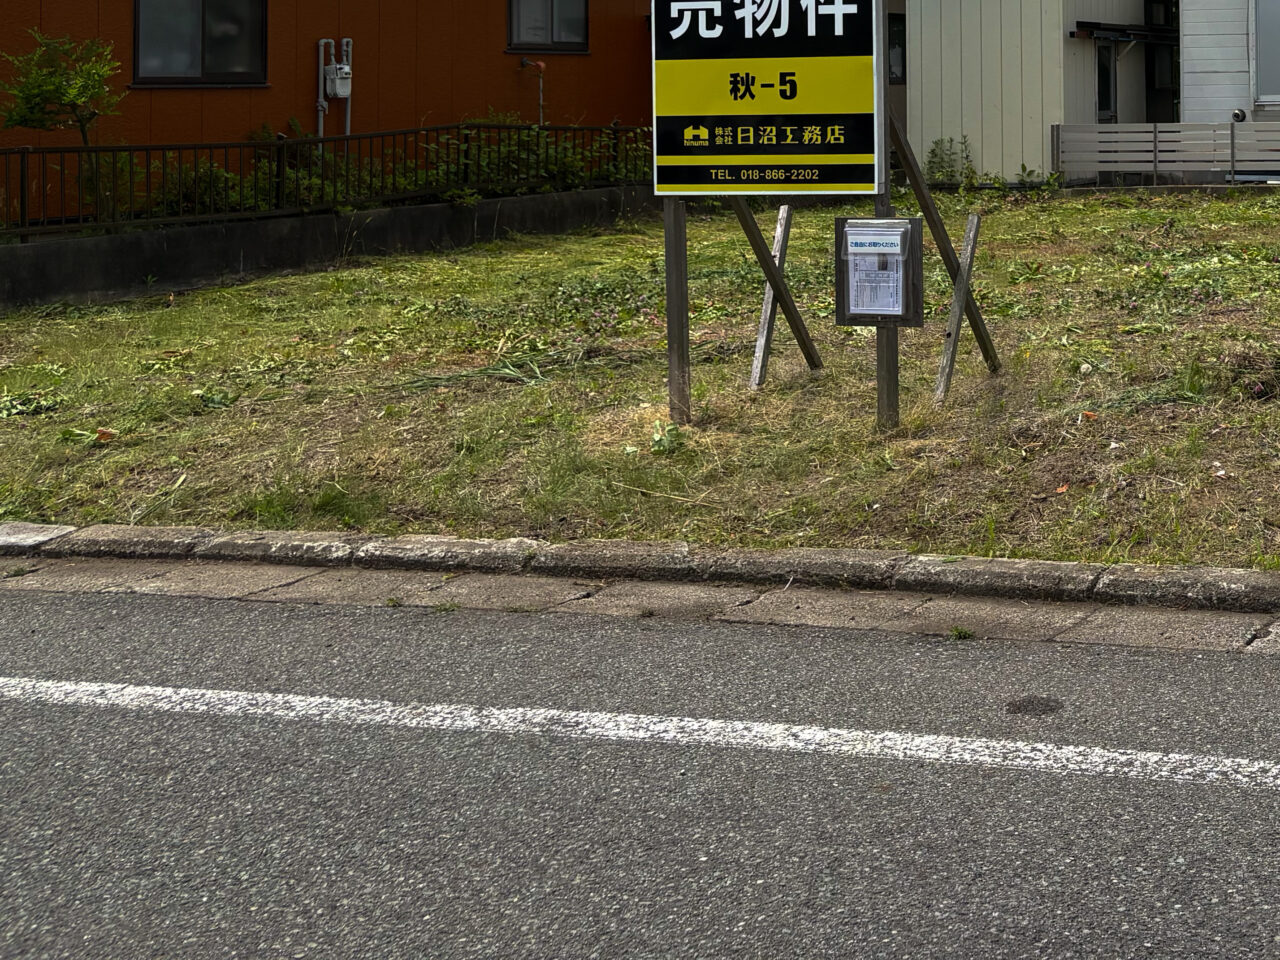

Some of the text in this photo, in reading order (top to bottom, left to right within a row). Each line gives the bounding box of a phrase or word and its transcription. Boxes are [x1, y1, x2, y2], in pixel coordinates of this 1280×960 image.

[715, 127, 733, 135] 株式
[737, 125, 845, 145] 日沼工務店
[715, 135, 733, 144] 会社
[710, 169, 819, 180] TEL. 018-866-2202
